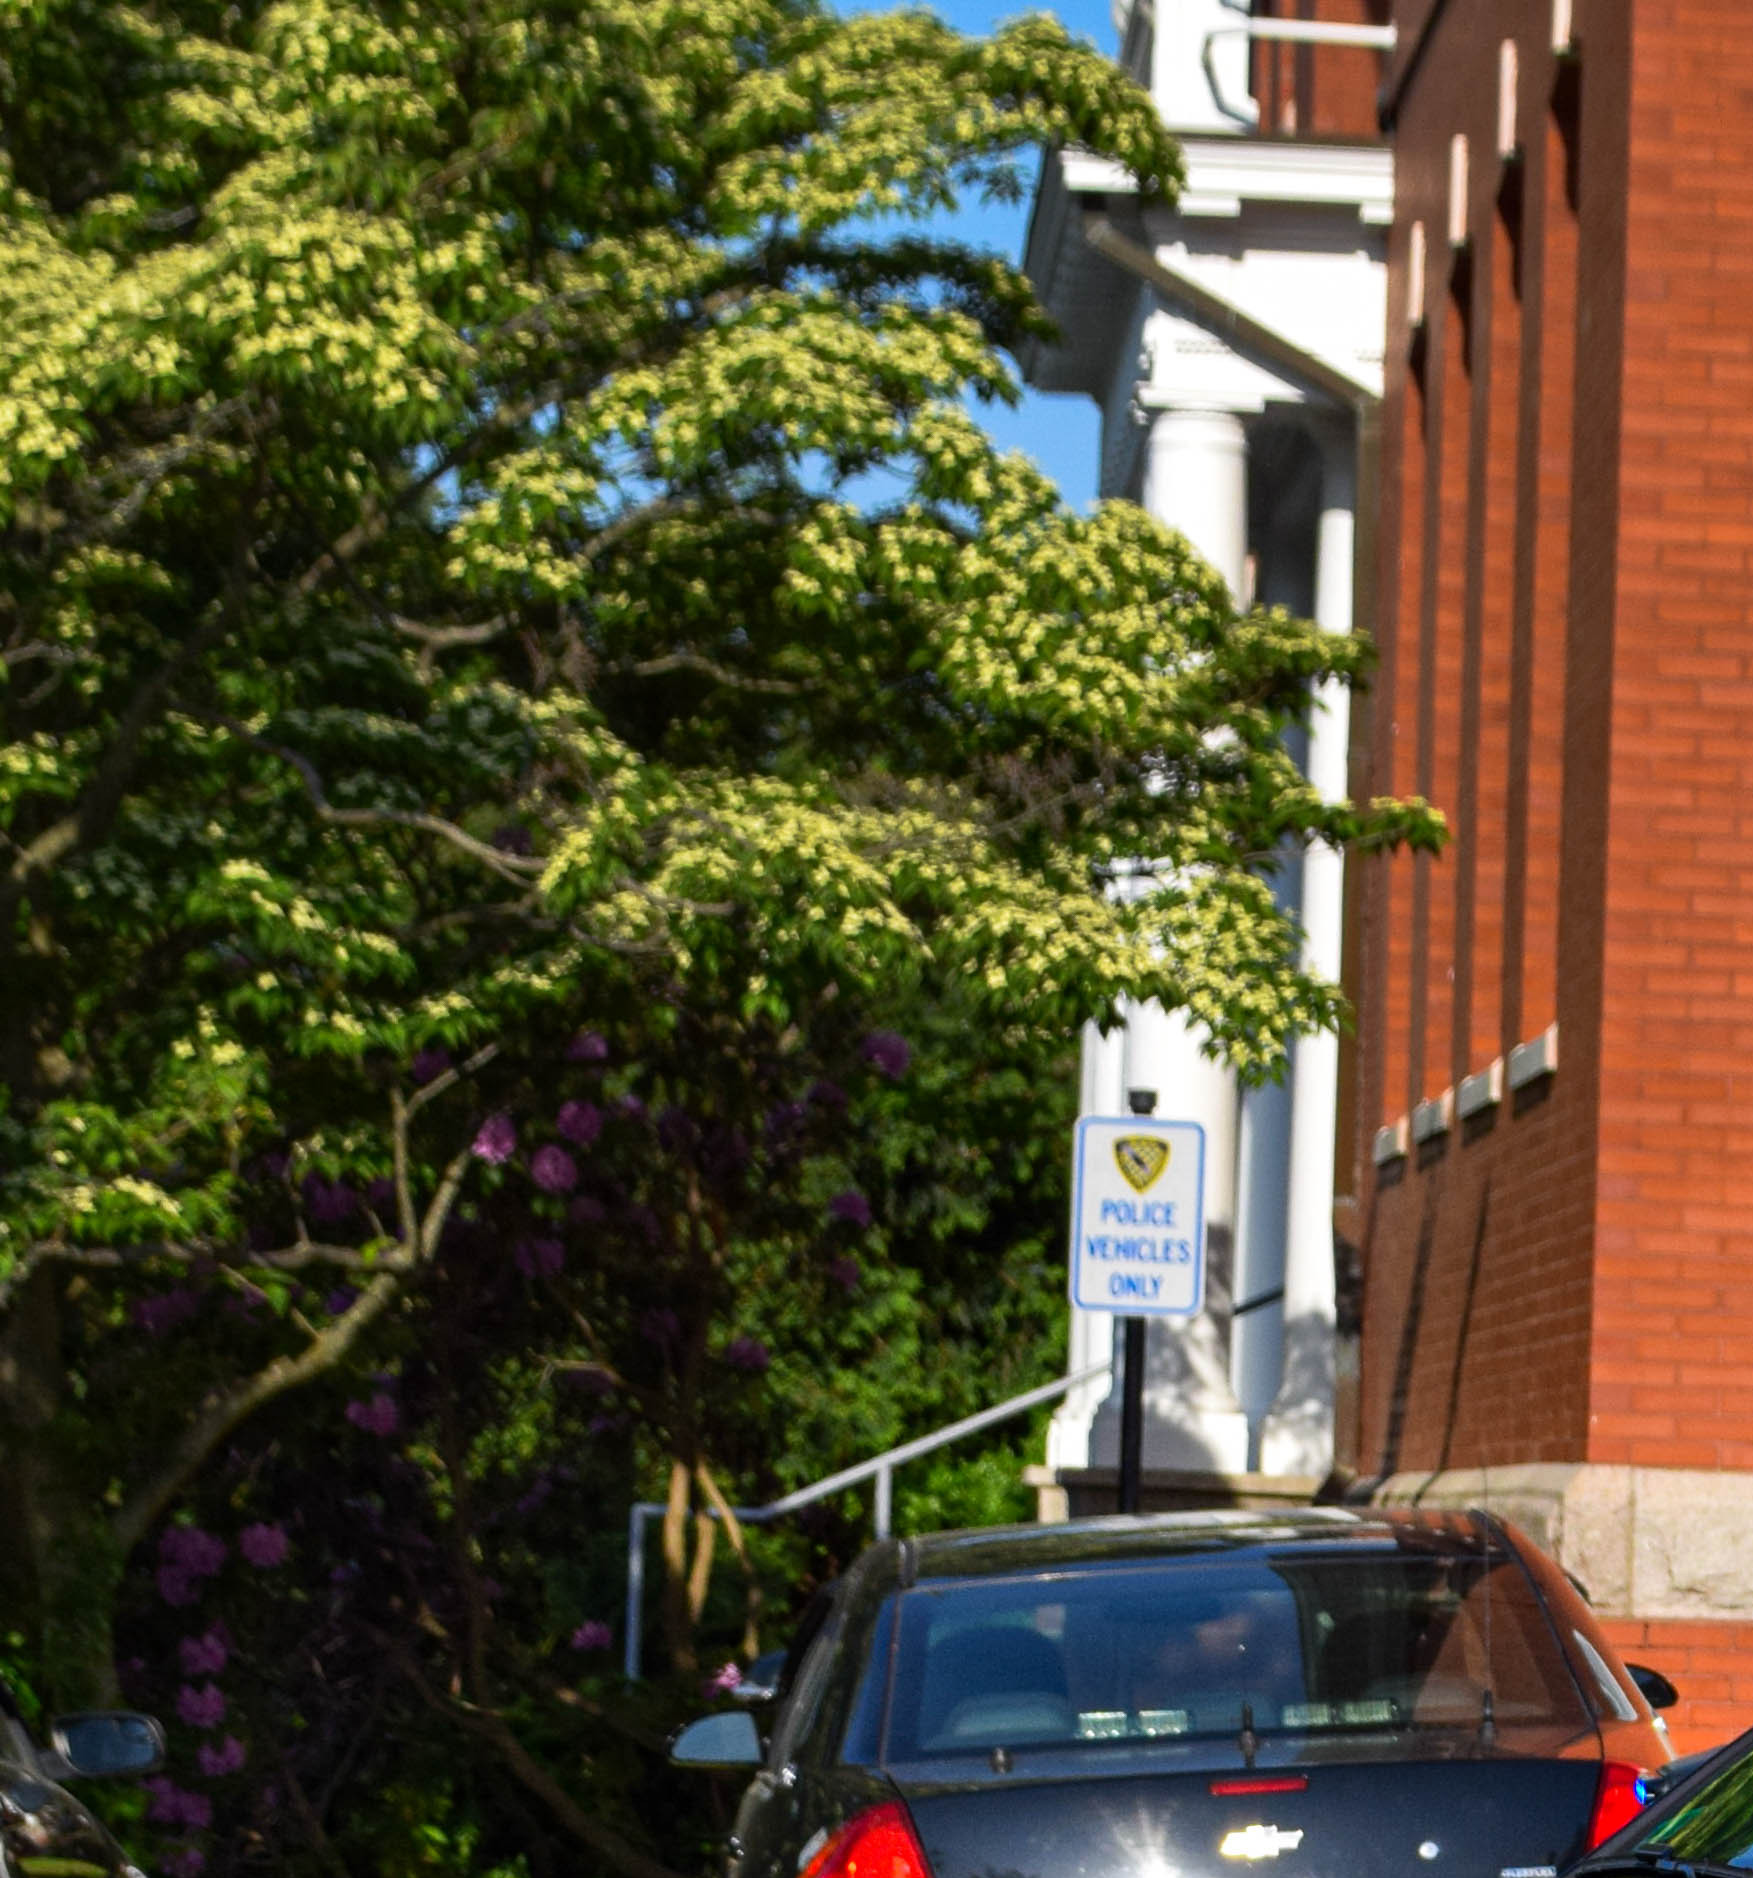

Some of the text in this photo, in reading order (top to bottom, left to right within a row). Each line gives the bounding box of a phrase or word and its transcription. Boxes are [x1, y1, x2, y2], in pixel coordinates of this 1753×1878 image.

[1101, 1199, 1177, 1227] POLICE
[1086, 1235, 1190, 1264] VEHICLES
[1110, 1271, 1163, 1298] ONLY
